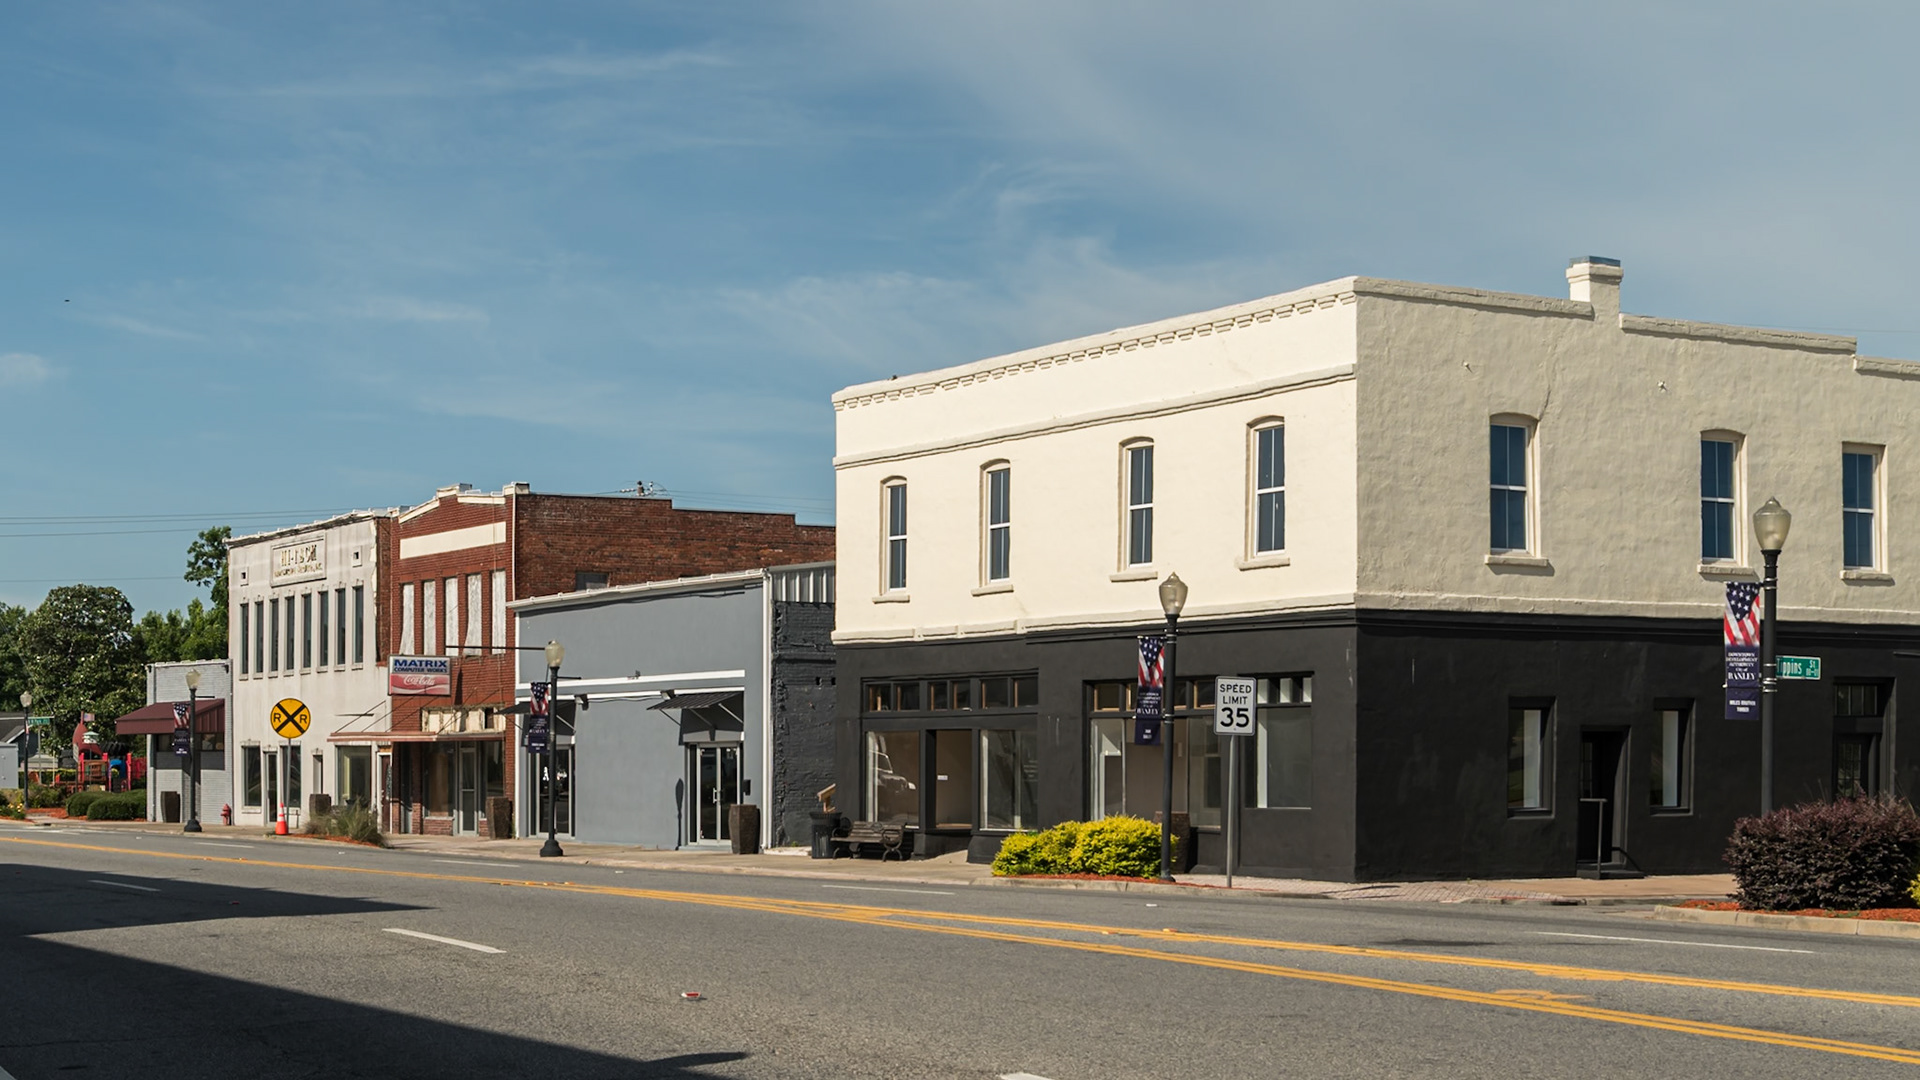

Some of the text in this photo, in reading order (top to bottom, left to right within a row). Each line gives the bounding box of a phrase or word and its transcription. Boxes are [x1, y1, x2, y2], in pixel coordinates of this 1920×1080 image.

[394, 659, 447, 668] MATRIX
[1220, 684, 1252, 693] SPEED
[1223, 696, 1248, 705] LIMIT
[1220, 707, 1249, 728] 35
